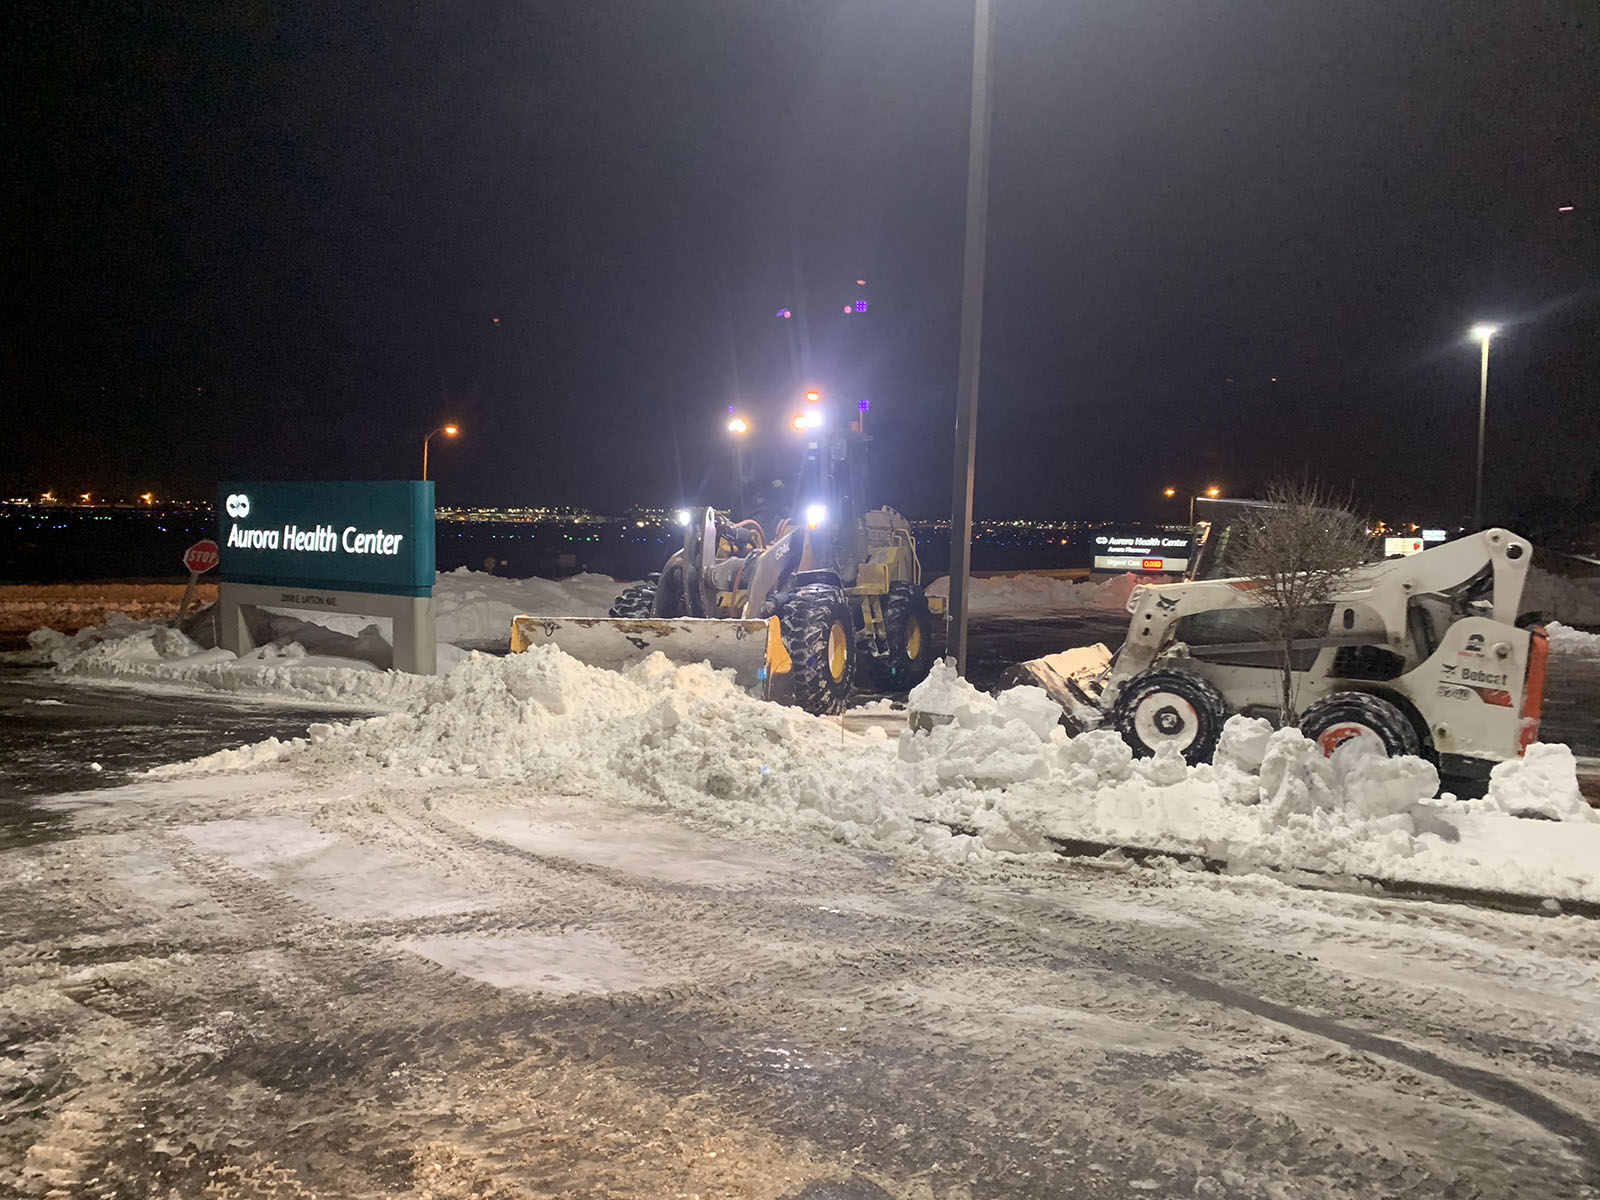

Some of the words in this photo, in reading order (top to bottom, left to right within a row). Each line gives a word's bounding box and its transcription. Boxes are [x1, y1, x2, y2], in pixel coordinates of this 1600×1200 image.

[227, 523, 279, 550] Aurora
[283, 525, 337, 552] Health
[342, 526, 403, 555] Center
[1108, 536, 1134, 546] Aurora
[1135, 537, 1160, 546] Health
[1161, 538, 1188, 547] Center
[189, 550, 218, 563] STOP
[1107, 559, 1126, 567] Urgent
[1461, 667, 1508, 686] Bobcat
